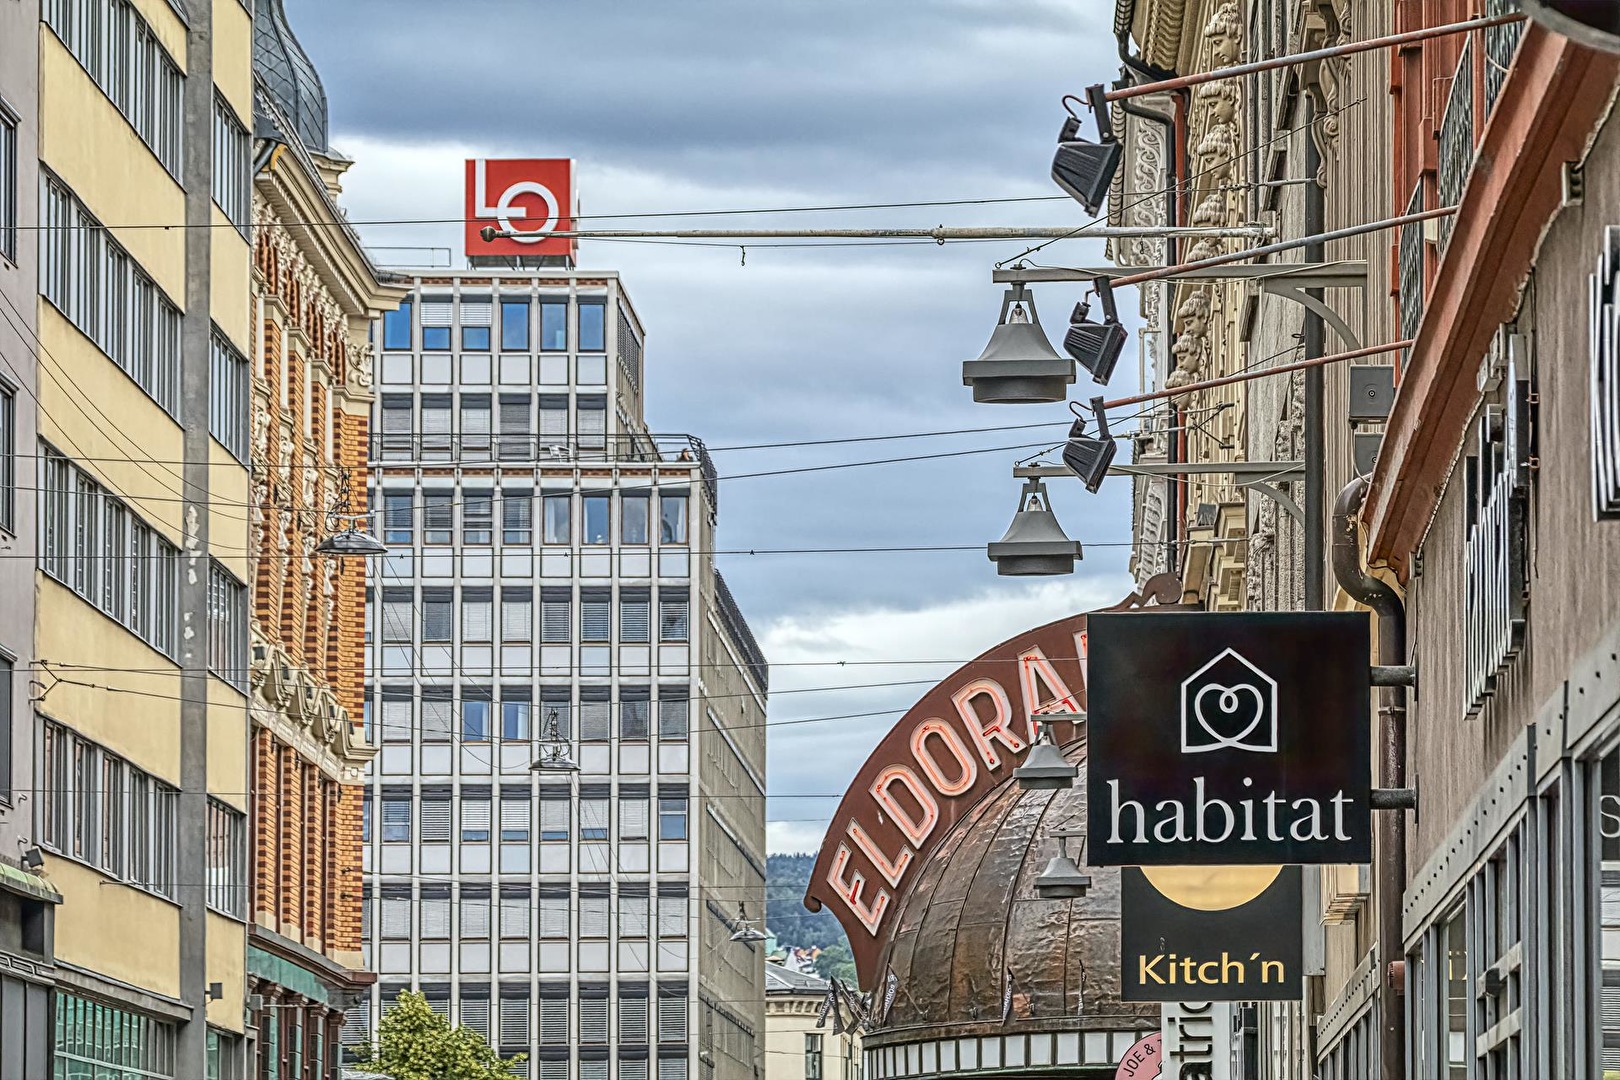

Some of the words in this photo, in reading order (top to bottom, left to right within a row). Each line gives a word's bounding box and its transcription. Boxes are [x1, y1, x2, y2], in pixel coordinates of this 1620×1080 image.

[474, 159, 559, 243] LO
[1106, 776, 1354, 844] habitat
[1123, 1050, 1145, 1078] JOE
[1143, 1043, 1156, 1056] &
